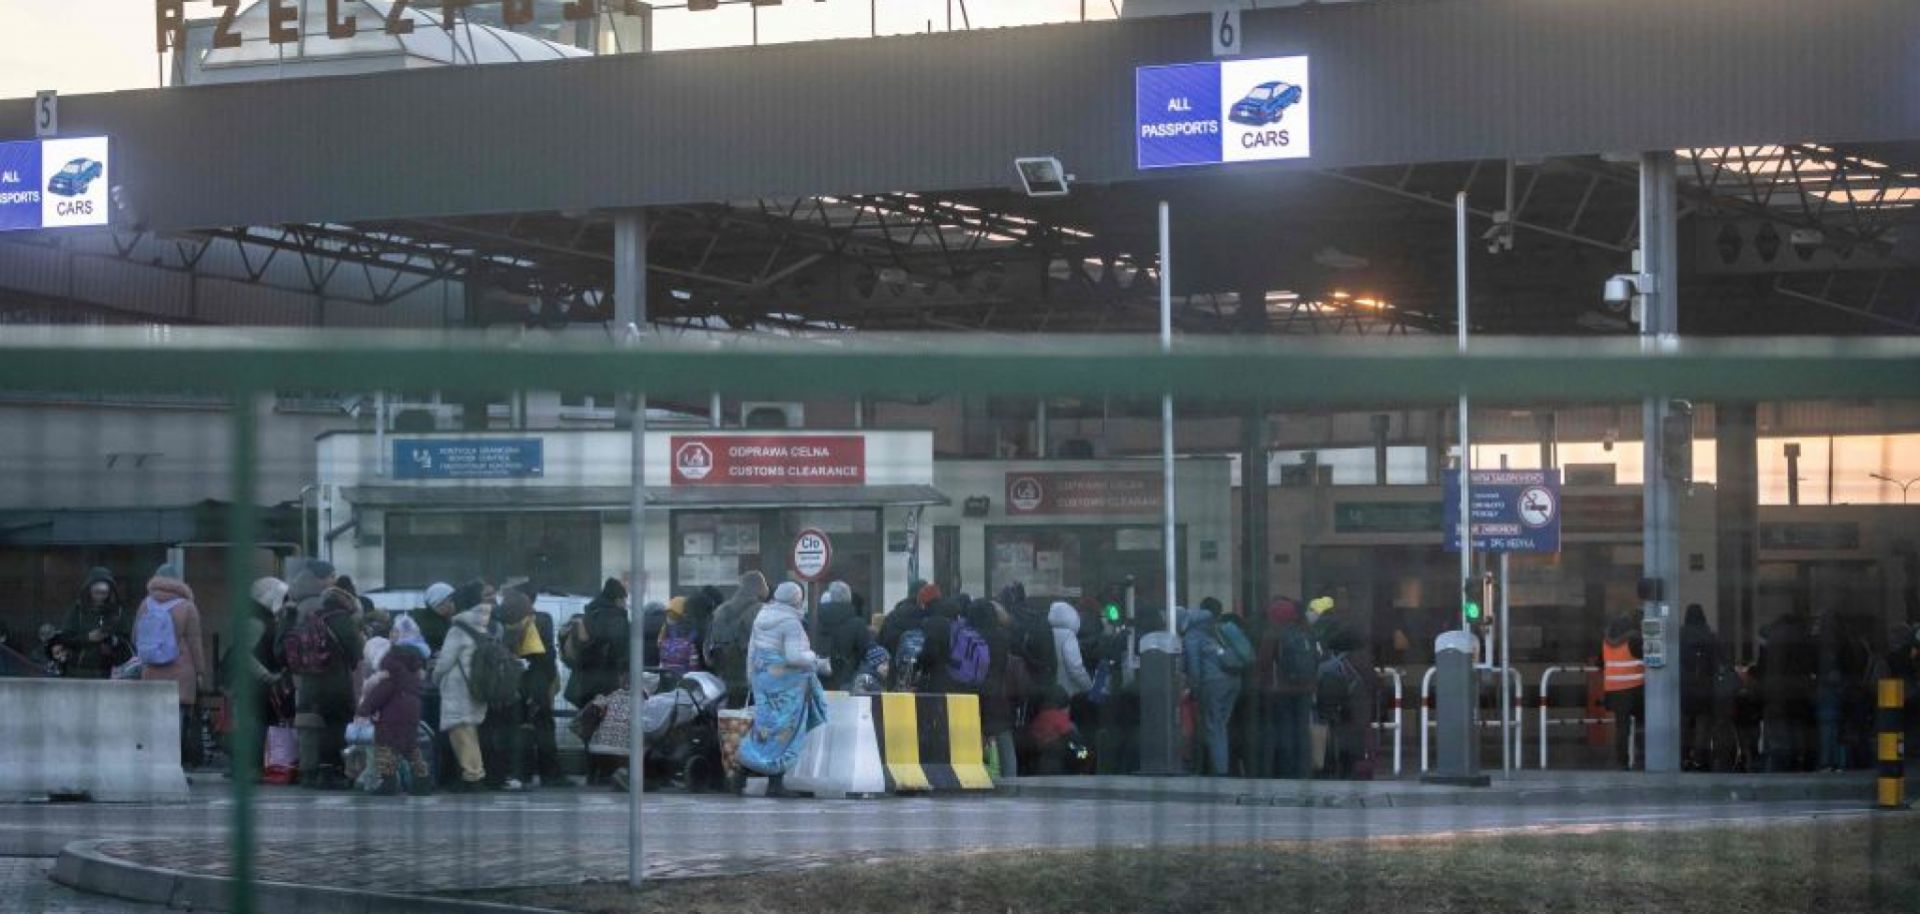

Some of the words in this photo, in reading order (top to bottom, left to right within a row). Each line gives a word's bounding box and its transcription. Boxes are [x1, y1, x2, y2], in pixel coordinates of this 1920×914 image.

[1220, 10, 1233, 47] 6
[1168, 97, 1192, 112] ALL
[41, 96, 51, 129] 5
[1141, 120, 1218, 138] PASSPORTS
[1241, 130, 1290, 149] CARS
[3, 171, 19, 182] ALL
[0, 191, 39, 203] SPORTS
[56, 200, 94, 216] CARS
[729, 446, 788, 457] ODPRAWA
[791, 446, 830, 457] CELNA
[729, 466, 784, 476] CUSTOMS
[788, 466, 858, 476] CLEARANCE
